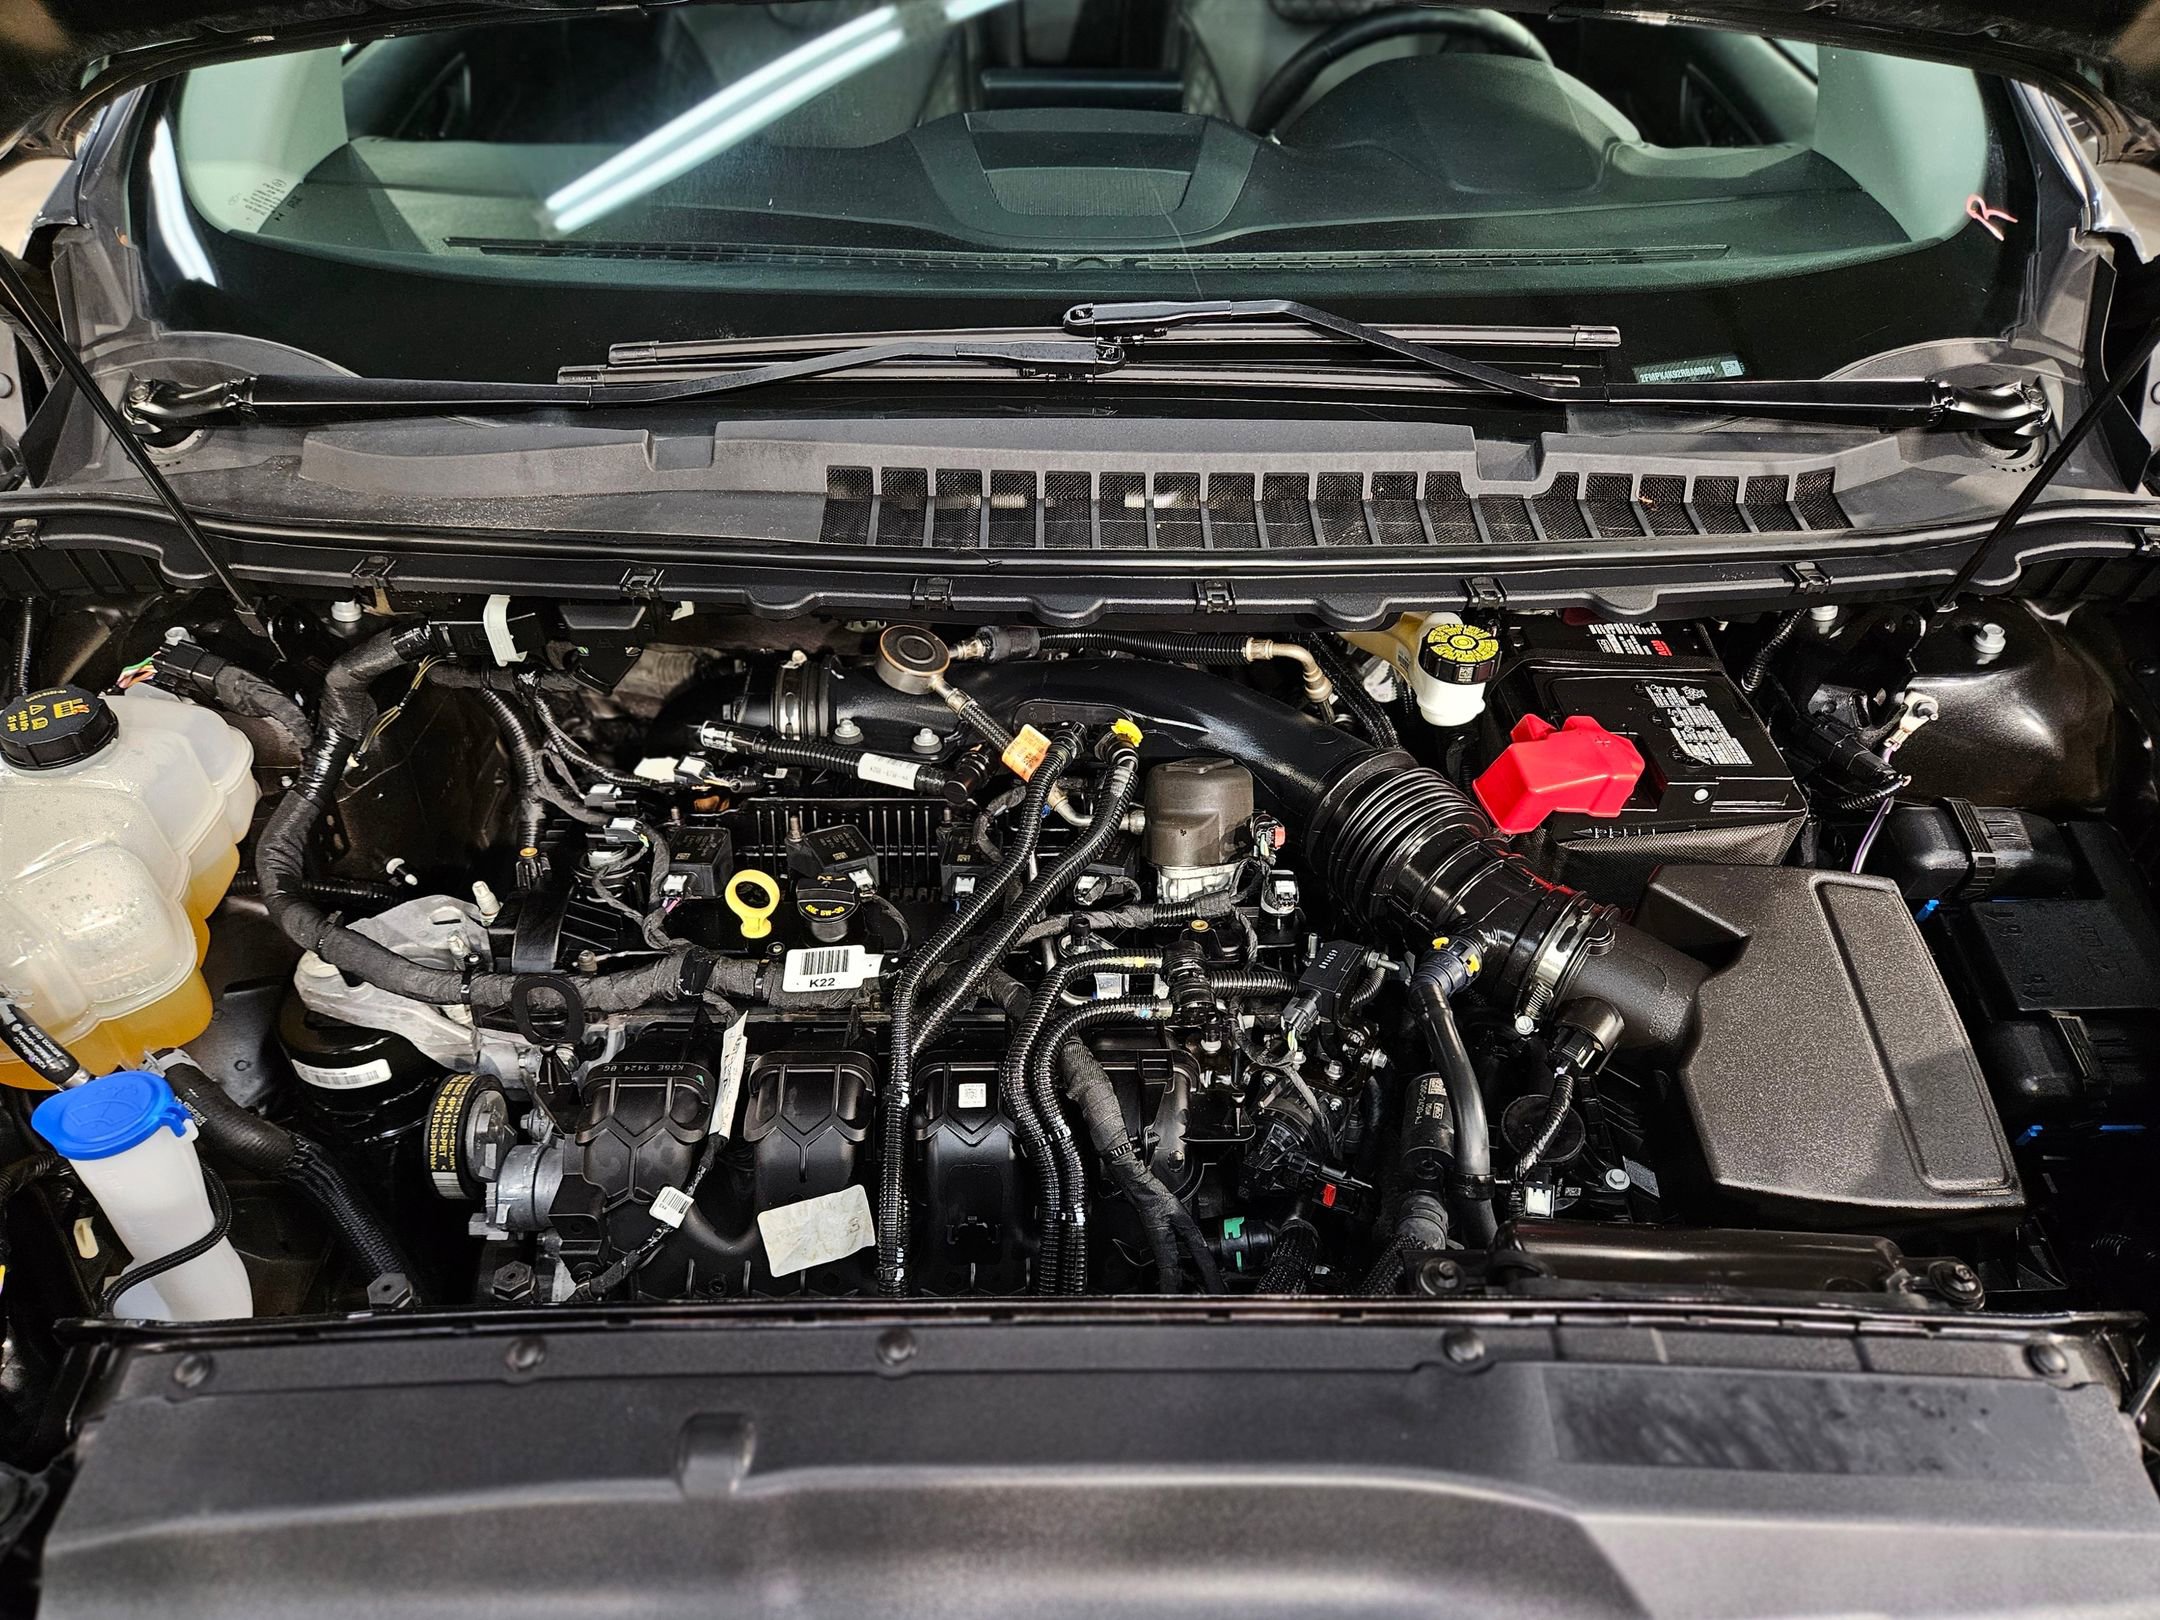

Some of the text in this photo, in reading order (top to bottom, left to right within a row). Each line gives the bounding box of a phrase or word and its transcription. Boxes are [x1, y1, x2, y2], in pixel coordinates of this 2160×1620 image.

[1966, 194, 2019, 241] R
[809, 977, 836, 988] K22
[624, 1064, 650, 1072] 9424
